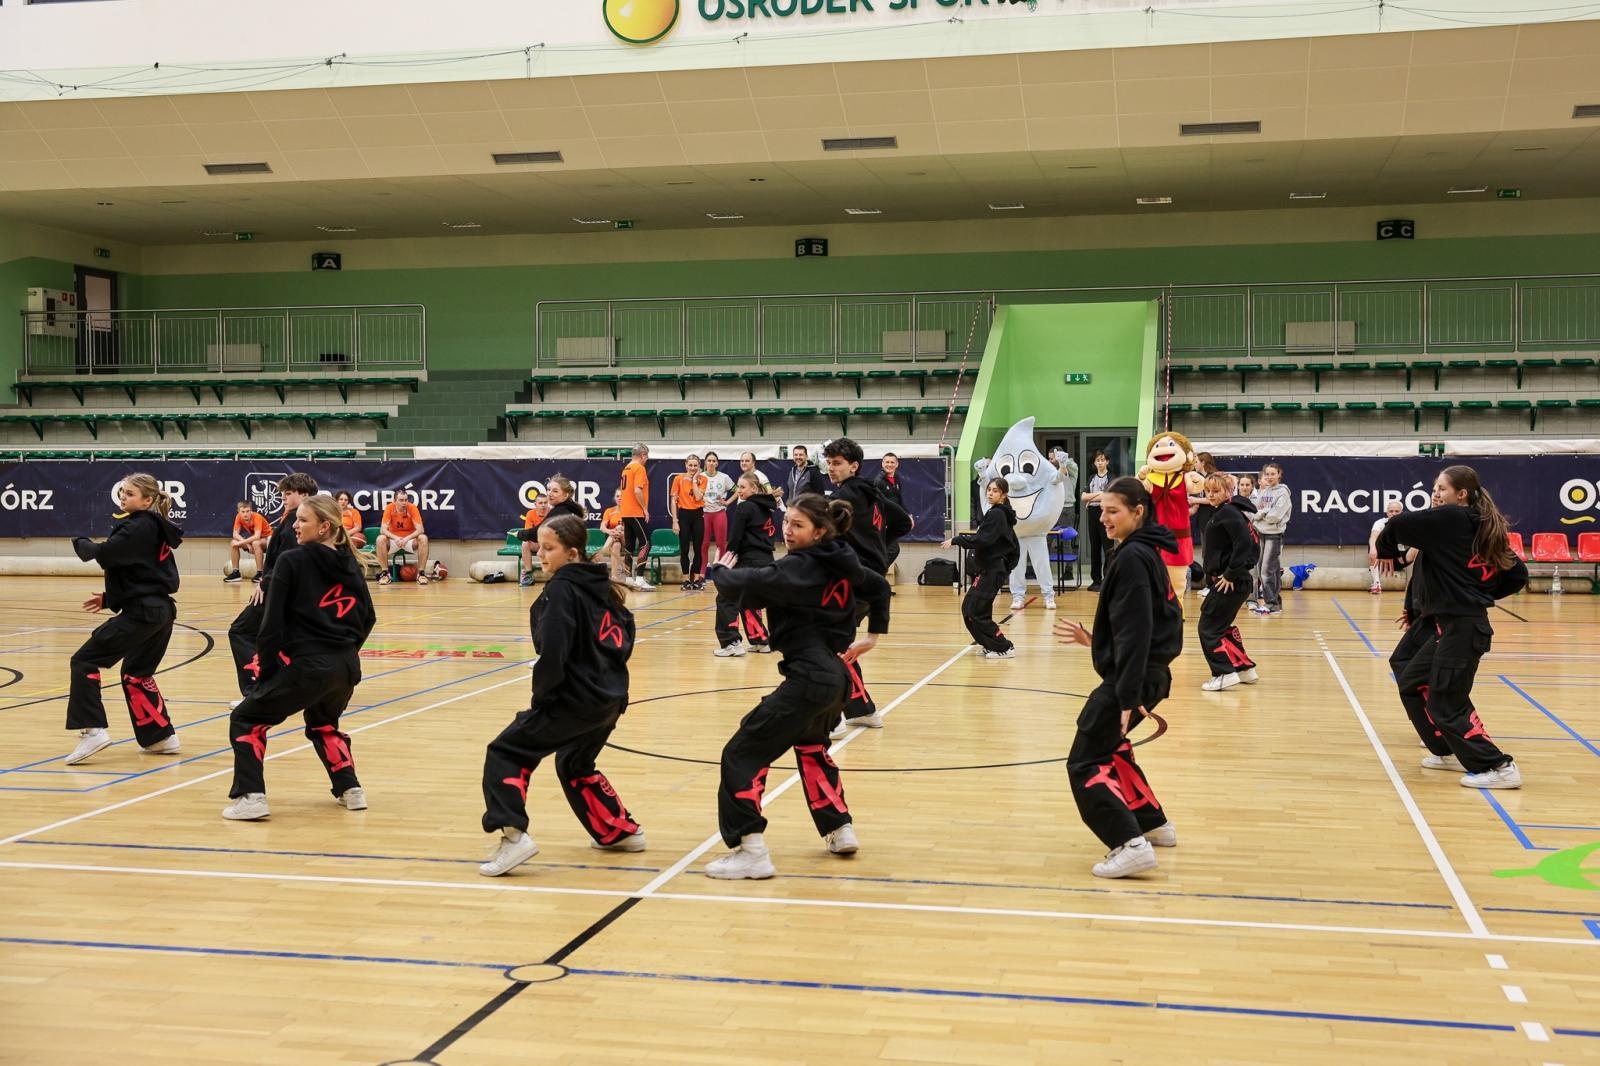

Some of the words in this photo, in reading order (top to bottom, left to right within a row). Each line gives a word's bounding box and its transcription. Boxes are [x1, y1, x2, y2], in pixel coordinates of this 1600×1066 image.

[1380, 226, 1393, 238] C
[1400, 225, 1412, 237] C
[322, 258, 338, 269] A
[1301, 481, 1434, 514] RACIBÓ
